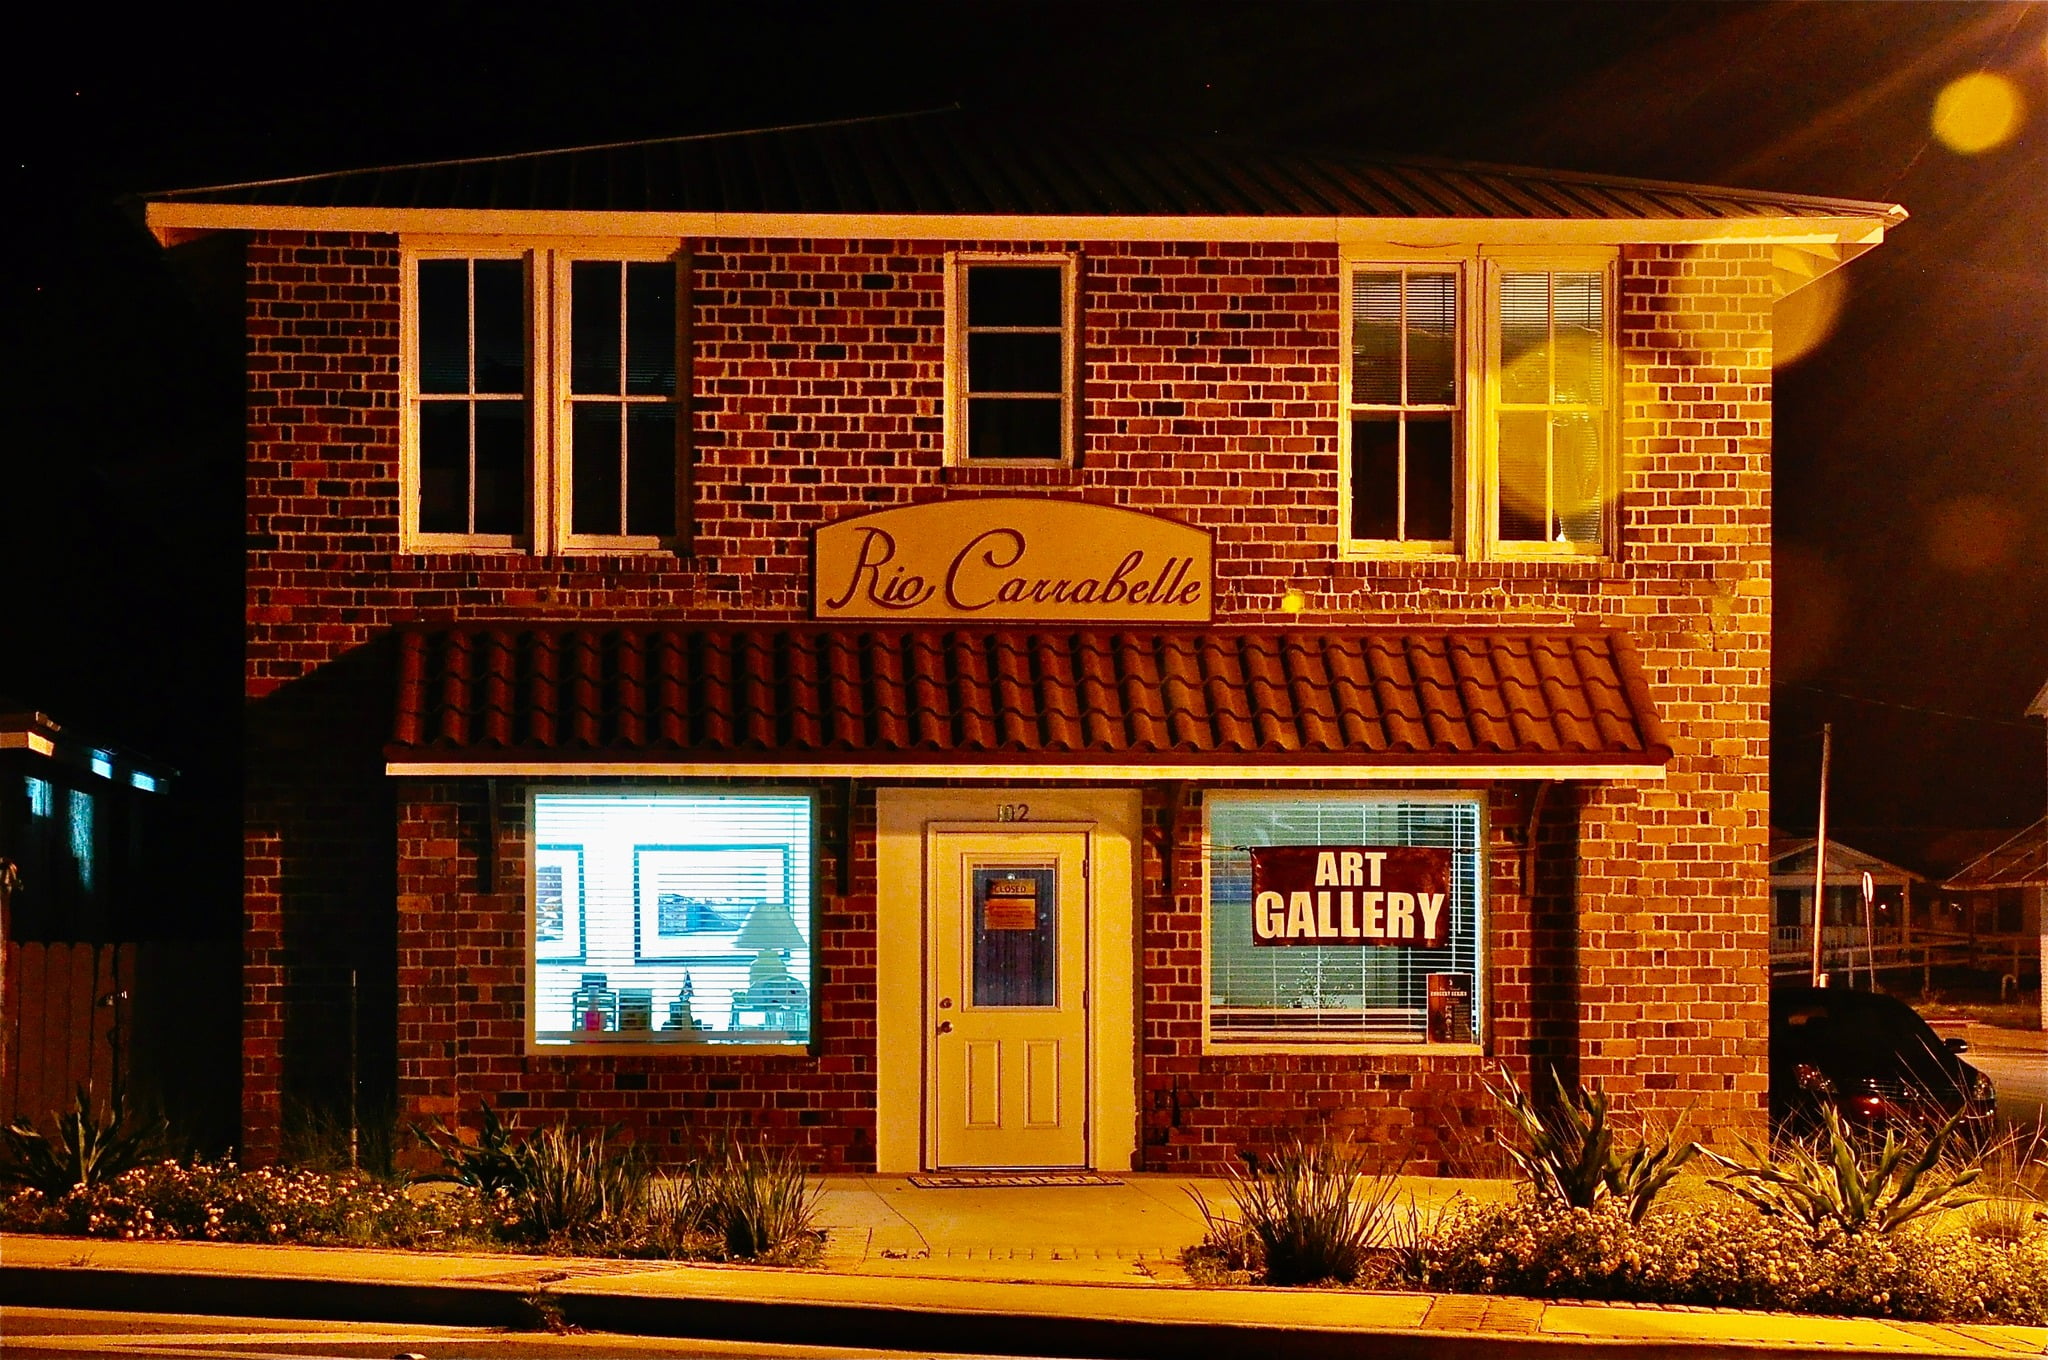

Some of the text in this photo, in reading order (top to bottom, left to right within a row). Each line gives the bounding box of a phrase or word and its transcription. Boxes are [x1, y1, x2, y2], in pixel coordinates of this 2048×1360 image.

[826, 526, 1202, 610] Rio Carrabelle
[997, 804, 1029, 822] 102
[1315, 851, 1387, 887] ART
[995, 885, 1027, 893] CLOSED
[1255, 891, 1446, 940] GALLERY
